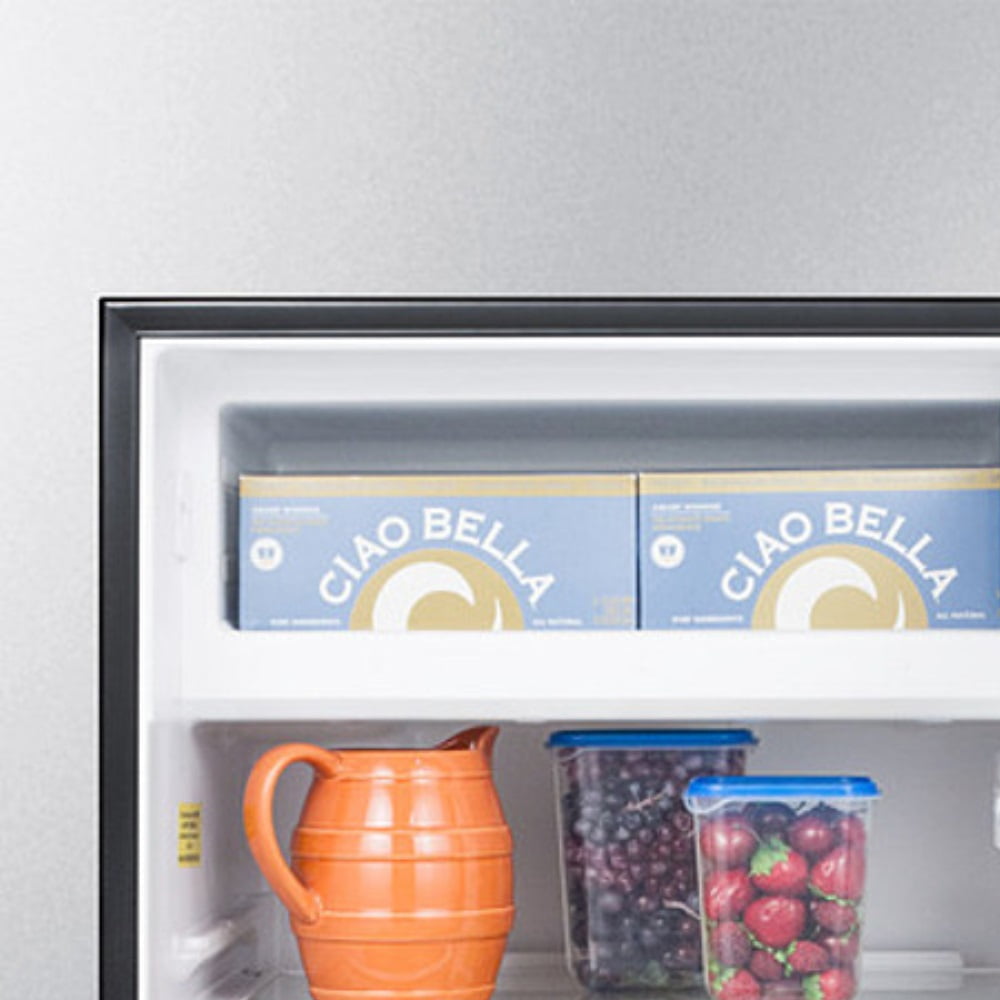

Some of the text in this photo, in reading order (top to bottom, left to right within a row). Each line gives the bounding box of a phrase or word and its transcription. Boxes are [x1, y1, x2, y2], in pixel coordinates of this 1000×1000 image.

[319, 506, 556, 609] CIAO BELLA
[720, 501, 959, 602] CIAO BELLA
